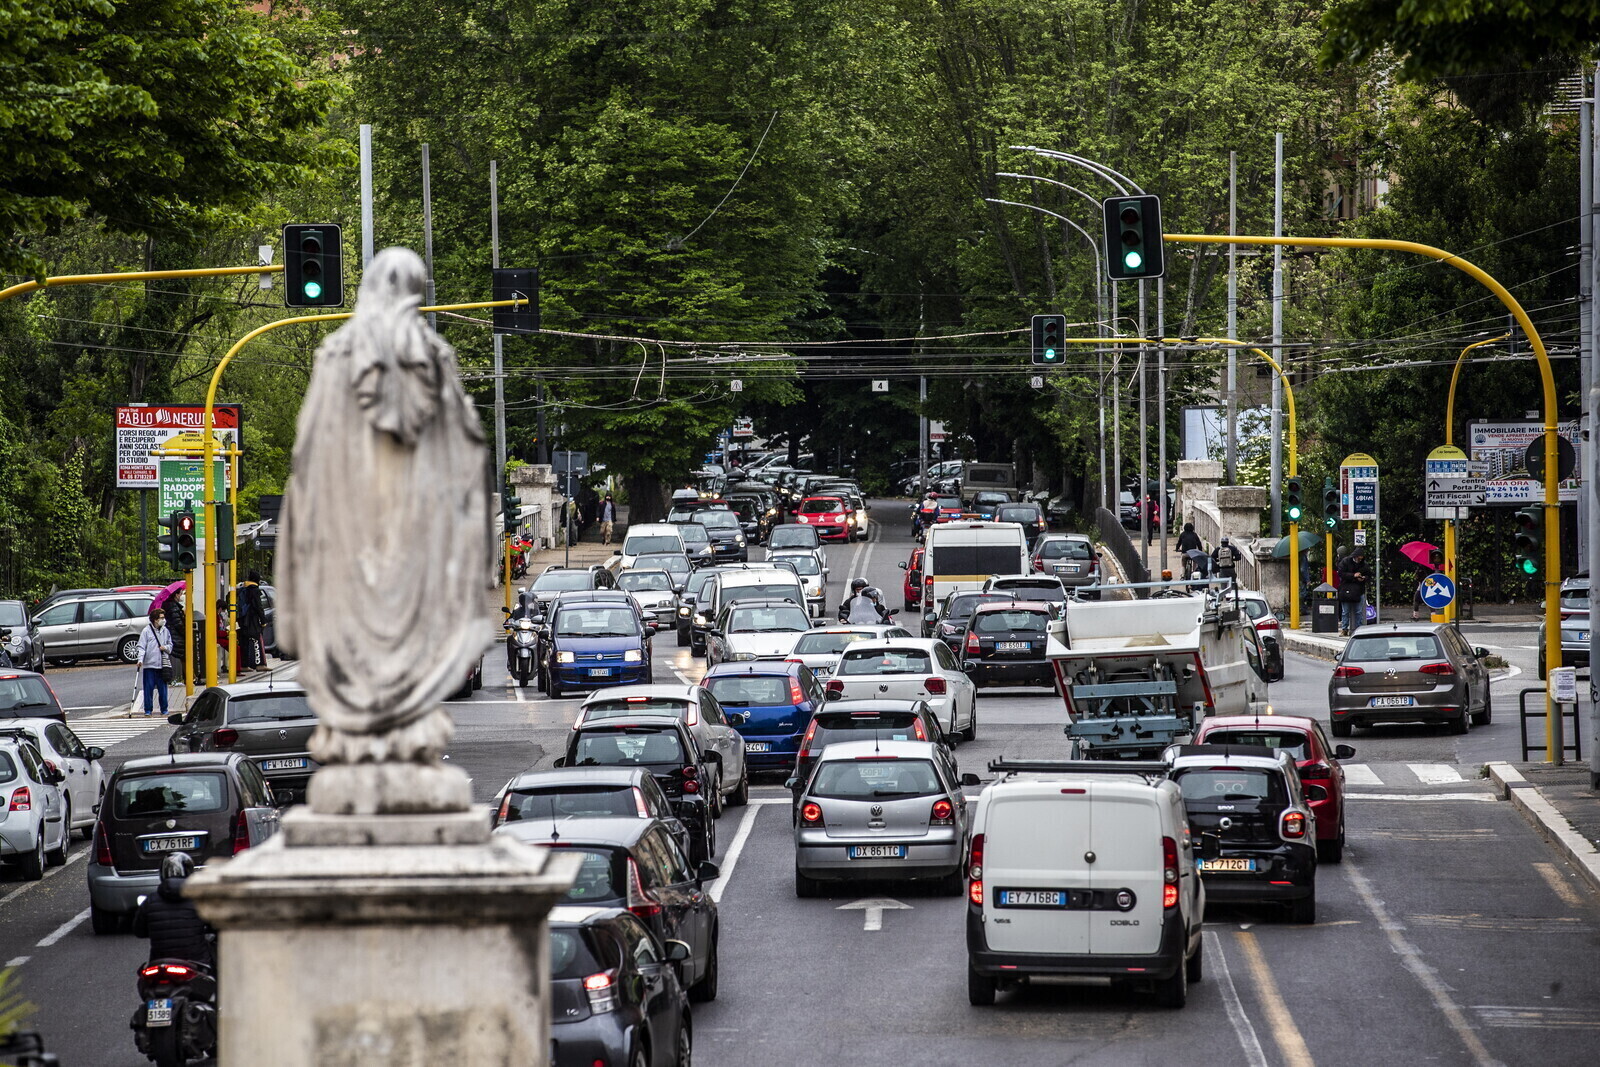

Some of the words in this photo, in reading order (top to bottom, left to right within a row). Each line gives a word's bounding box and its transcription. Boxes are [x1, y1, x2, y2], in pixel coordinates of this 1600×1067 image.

[118, 412, 153, 424] PABLO
[266, 760, 278, 769] FW
[280, 759, 302, 768] 148YT
[150, 840, 161, 850] CX
[164, 838, 193, 848] 761RF
[856, 846, 867, 856] DX
[870, 846, 898, 856] 861TC
[1008, 892, 1022, 903] EY
[1025, 892, 1058, 903] 716BG
